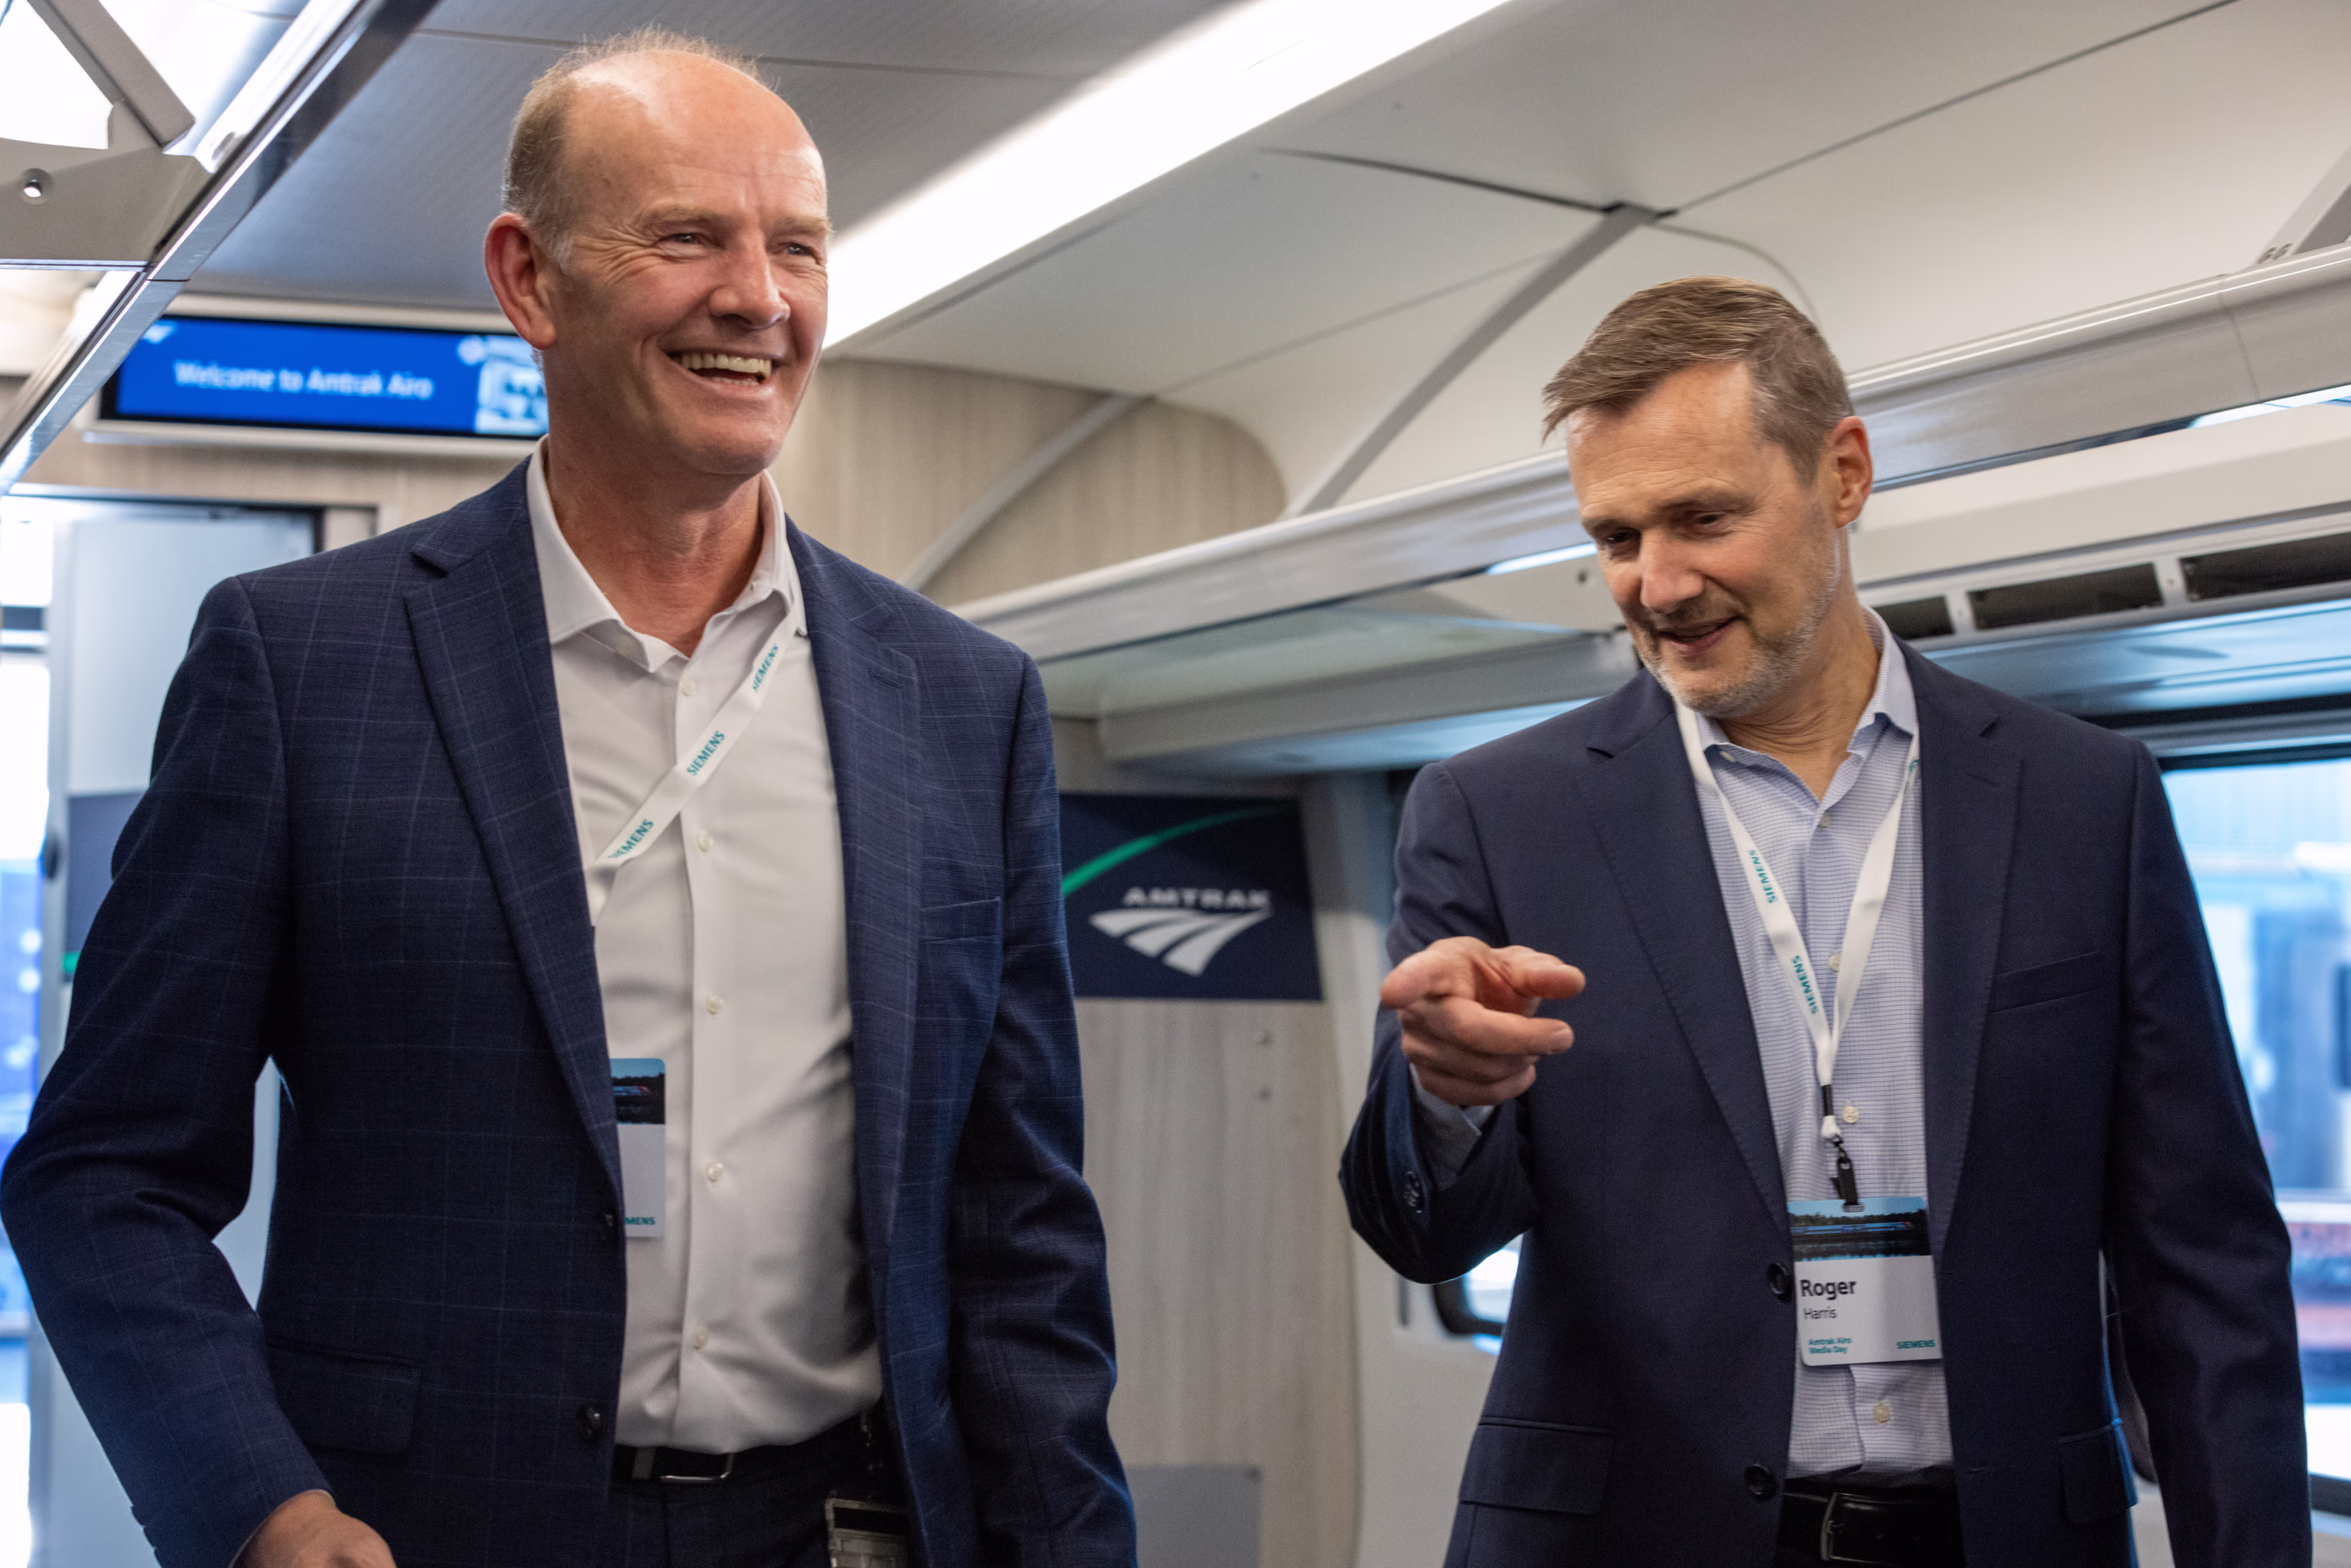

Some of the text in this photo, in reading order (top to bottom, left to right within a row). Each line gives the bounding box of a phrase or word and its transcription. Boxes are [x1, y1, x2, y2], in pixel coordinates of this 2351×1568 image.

[174, 360, 276, 392] Welcome
[278, 368, 304, 392] to
[307, 367, 383, 397] Amtrak
[686, 730, 725, 776] SIEMENS
[1749, 850, 1779, 903] SIEMENS
[1123, 887, 1271, 909] AMTRAK
[1791, 955, 1818, 1014] SIEMENS
[1800, 1280, 1857, 1300] Roger
[1803, 1306, 1837, 1319] Harris
[1897, 1340, 1935, 1349] SIEMENS
